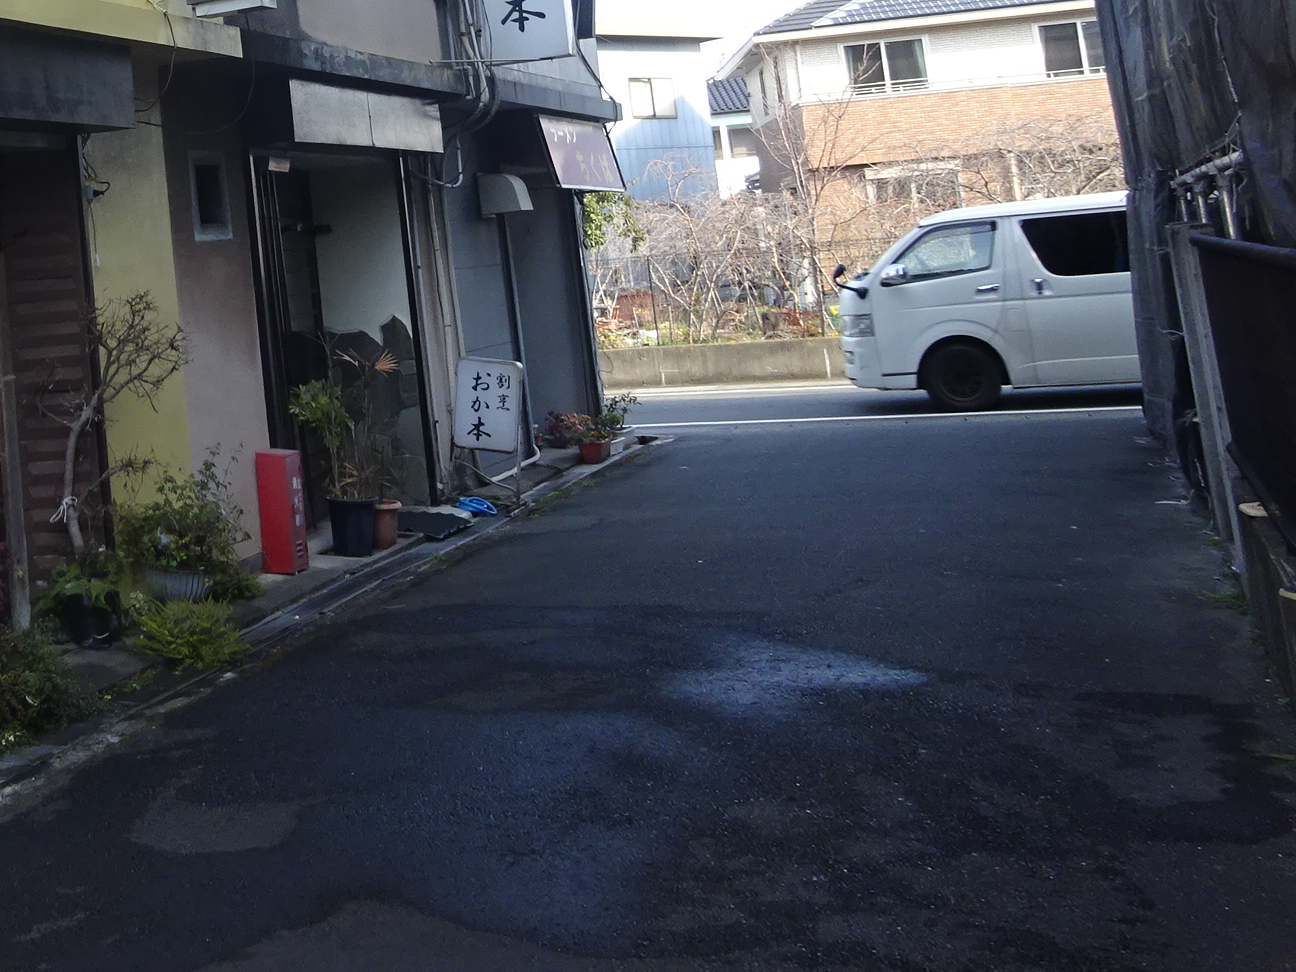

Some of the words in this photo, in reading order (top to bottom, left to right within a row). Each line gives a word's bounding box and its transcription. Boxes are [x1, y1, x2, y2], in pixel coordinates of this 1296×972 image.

[467, 370, 492, 442] おか本
[495, 372, 511, 412] 割烹
